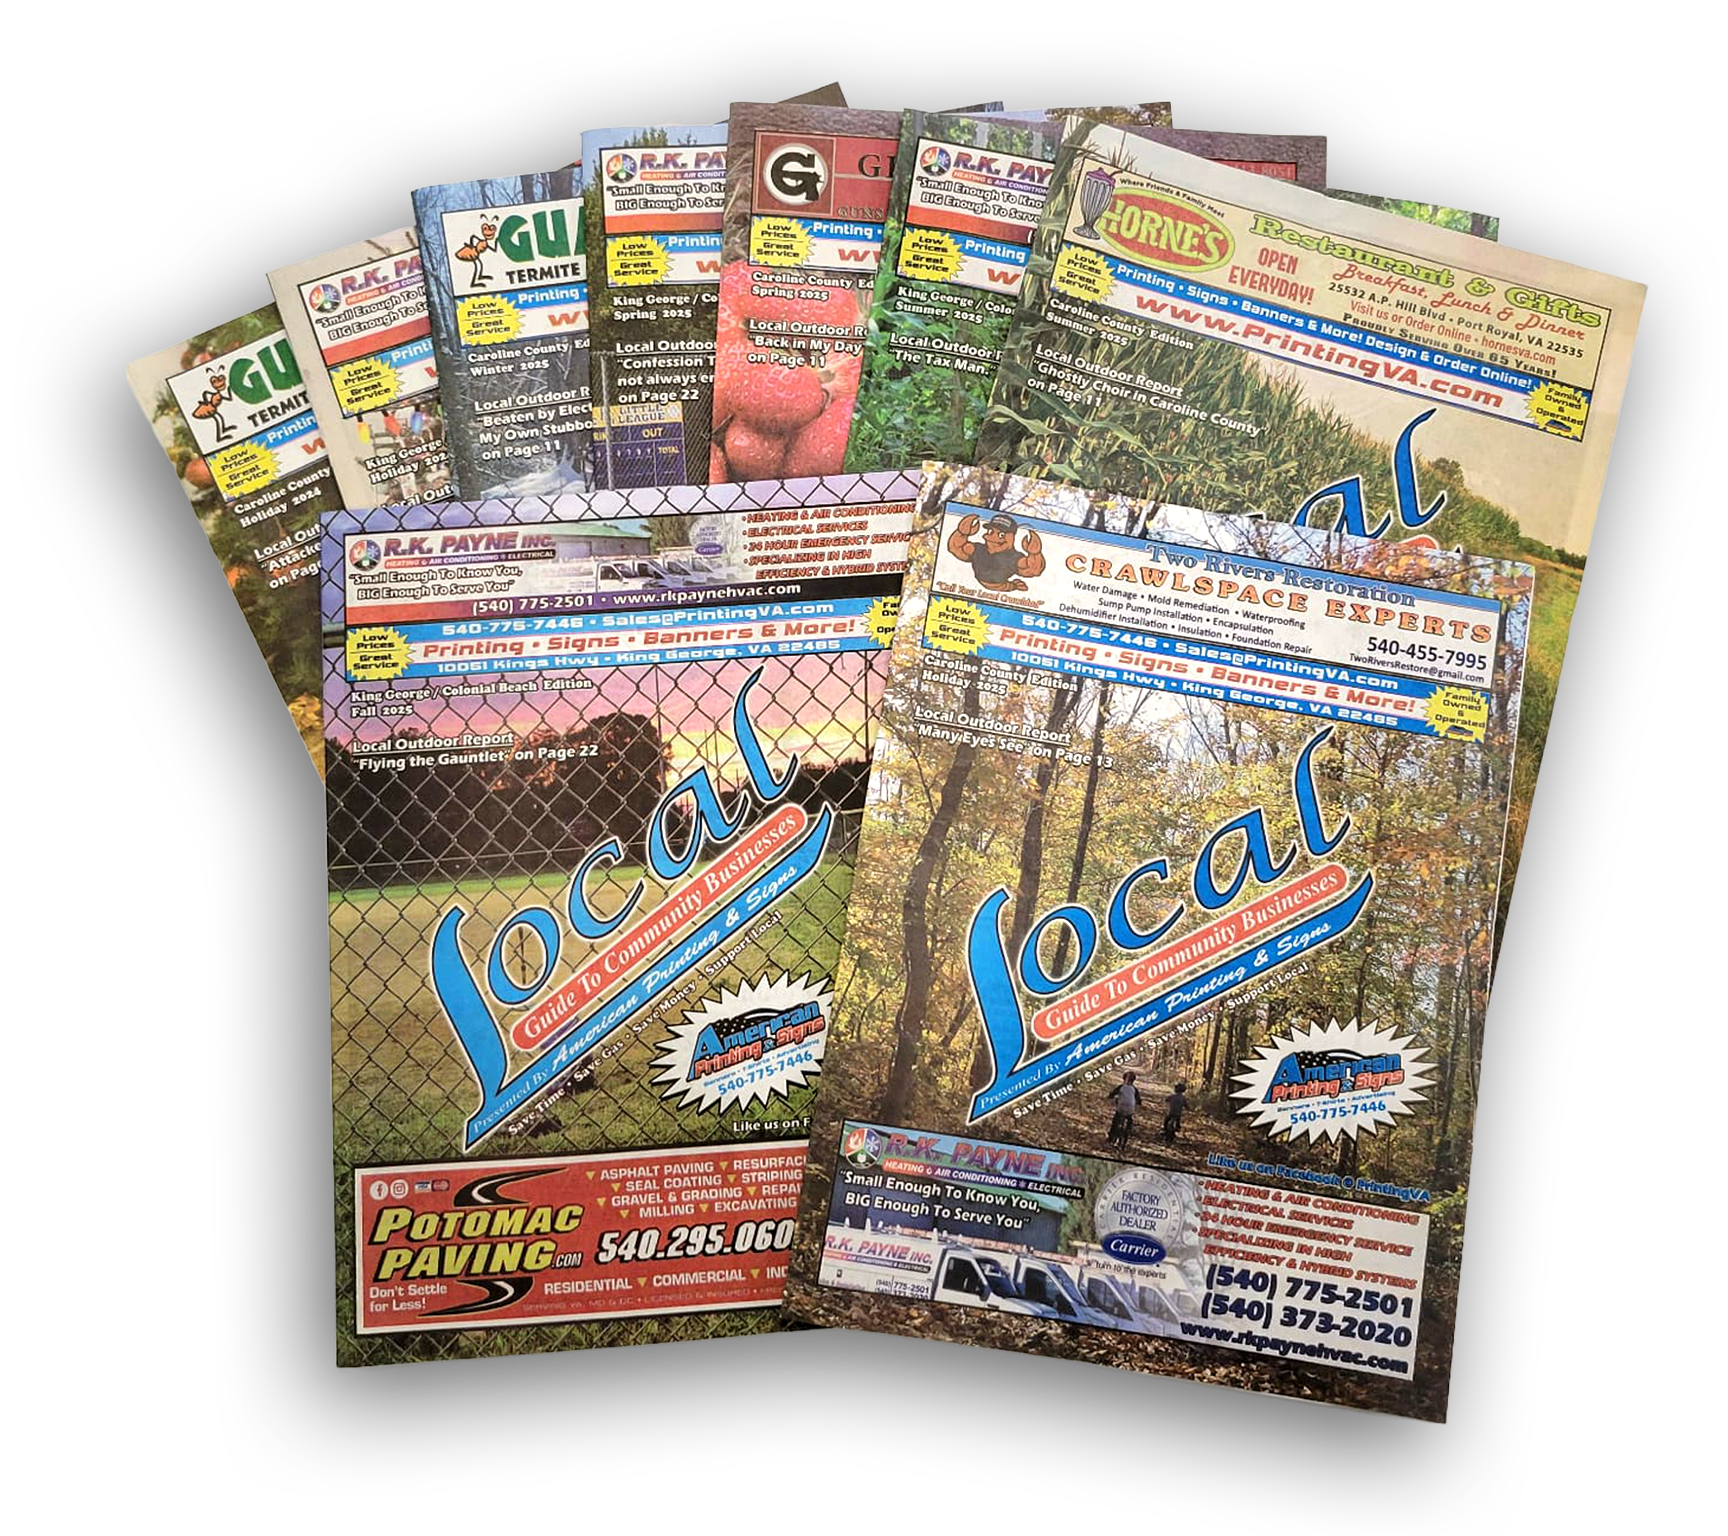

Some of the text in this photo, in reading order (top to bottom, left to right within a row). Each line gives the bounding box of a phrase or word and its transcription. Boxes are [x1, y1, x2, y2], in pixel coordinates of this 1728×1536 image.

[813, 221, 873, 239] Printing
[506, 262, 580, 285] TERMITE
[1250, 215, 1602, 328] Restaurant & Gifts
[1258, 248, 1299, 276] OPEN
[752, 272, 853, 290] Caroline County
[752, 286, 829, 301] Spring 2025
[1228, 265, 1315, 306] EVERYDAY!
[895, 302, 983, 324] Summer 2025
[898, 287, 974, 310] King George
[1333, 264, 1585, 340] Breakfast, Lunch & Dinner
[613, 310, 692, 321] Spring 2025
[750, 319, 851, 336] Local Outdoor
[1046, 312, 1128, 346] Summer 2025
[1050, 299, 1194, 350] Caroline County Edition
[1116, 264, 1532, 388] Printing Signs Banners & More! Design & Order Online!
[1328, 283, 1584, 358] 25532 A.P. Hill Blvd Port Royal, VA 22535
[468, 342, 570, 362] Caroline County
[748, 353, 826, 367] on Page 11
[1136, 296, 1503, 408] www.PrintingVA.com
[470, 360, 549, 377] Winter 2025
[617, 375, 696, 386] not always
[1036, 344, 1184, 398] Local Outdoor Report
[619, 389, 699, 405] on Page 22
[1028, 379, 1102, 408] on Page 11
[1092, 380, 1130, 398] Choir
[1132, 389, 1148, 402] in
[1150, 396, 1208, 421] Caroline
[643, 428, 664, 438] OUT
[221, 452, 258, 472] Prices
[224, 450, 248, 463] Low
[365, 438, 442, 470] King George
[482, 439, 560, 461] on Page 11
[226, 468, 269, 490] Service
[229, 464, 260, 481] Great
[234, 466, 330, 514] Caroline County
[240, 487, 322, 529] Holiday 2024
[383, 532, 556, 556] R.K. PAYNE INC.
[1147, 545, 1416, 608] Two Rivers Restoration
[472, 584, 801, 615] (540) 775-2501 www.rkpaynehvac.com
[1065, 554, 1491, 643] CRAWLSPACE EXPERTS
[1073, 580, 1305, 630] Water Damage Mold Remediation Waterproofing
[442, 603, 834, 635] 540-775-7446 Sales@PrintingVA.com
[423, 620, 855, 658] Printing Signs Banners & More!
[1022, 615, 1399, 690] 540-775-7446 Sales@PrintingVA.com
[1349, 653, 1485, 683] TwoRiversRestore@gmail.com
[1367, 637, 1487, 671] 540-455-7995
[922, 670, 1007, 696] Holiday 2025
[925, 655, 1078, 692] Caroline County Edition
[351, 690, 382, 703] King
[383, 687, 430, 701] George
[442, 683, 496, 697] Colonial
[499, 679, 537, 693] Beach
[543, 678, 593, 691] Edition
[351, 704, 413, 717] Fall 2025
[430, 665, 798, 1150] Local
[524, 814, 798, 1040] Guide To Community Businesses
[968, 725, 1351, 1124] Local
[1046, 871, 1338, 1031] Guide To Community Businesses
[718, 1051, 813, 1095] 540-775-7446
[601, 1161, 714, 1180] ASPHALT PAVING
[625, 1170, 803, 1192] SEAL COATING STRIPING
[886, 1178, 942, 1198] Enough
[945, 1186, 962, 1198] To
[966, 1189, 1008, 1205] Know
[1011, 1197, 1041, 1213] You,
[1121, 1190, 1160, 1206] FACTORY
[368, 1204, 584, 1245] POTOMAC
[1110, 1203, 1168, 1220] AUTHORIZED
[1119, 1216, 1157, 1232] DEALER
[1109, 1238, 1159, 1259] Carrier
[544, 1270, 746, 1294] RESIDENTIAL COMMERCIAL
[1207, 1265, 1413, 1318] (540) 775-2501
[1201, 1292, 1412, 1348] (540) 373-2020
